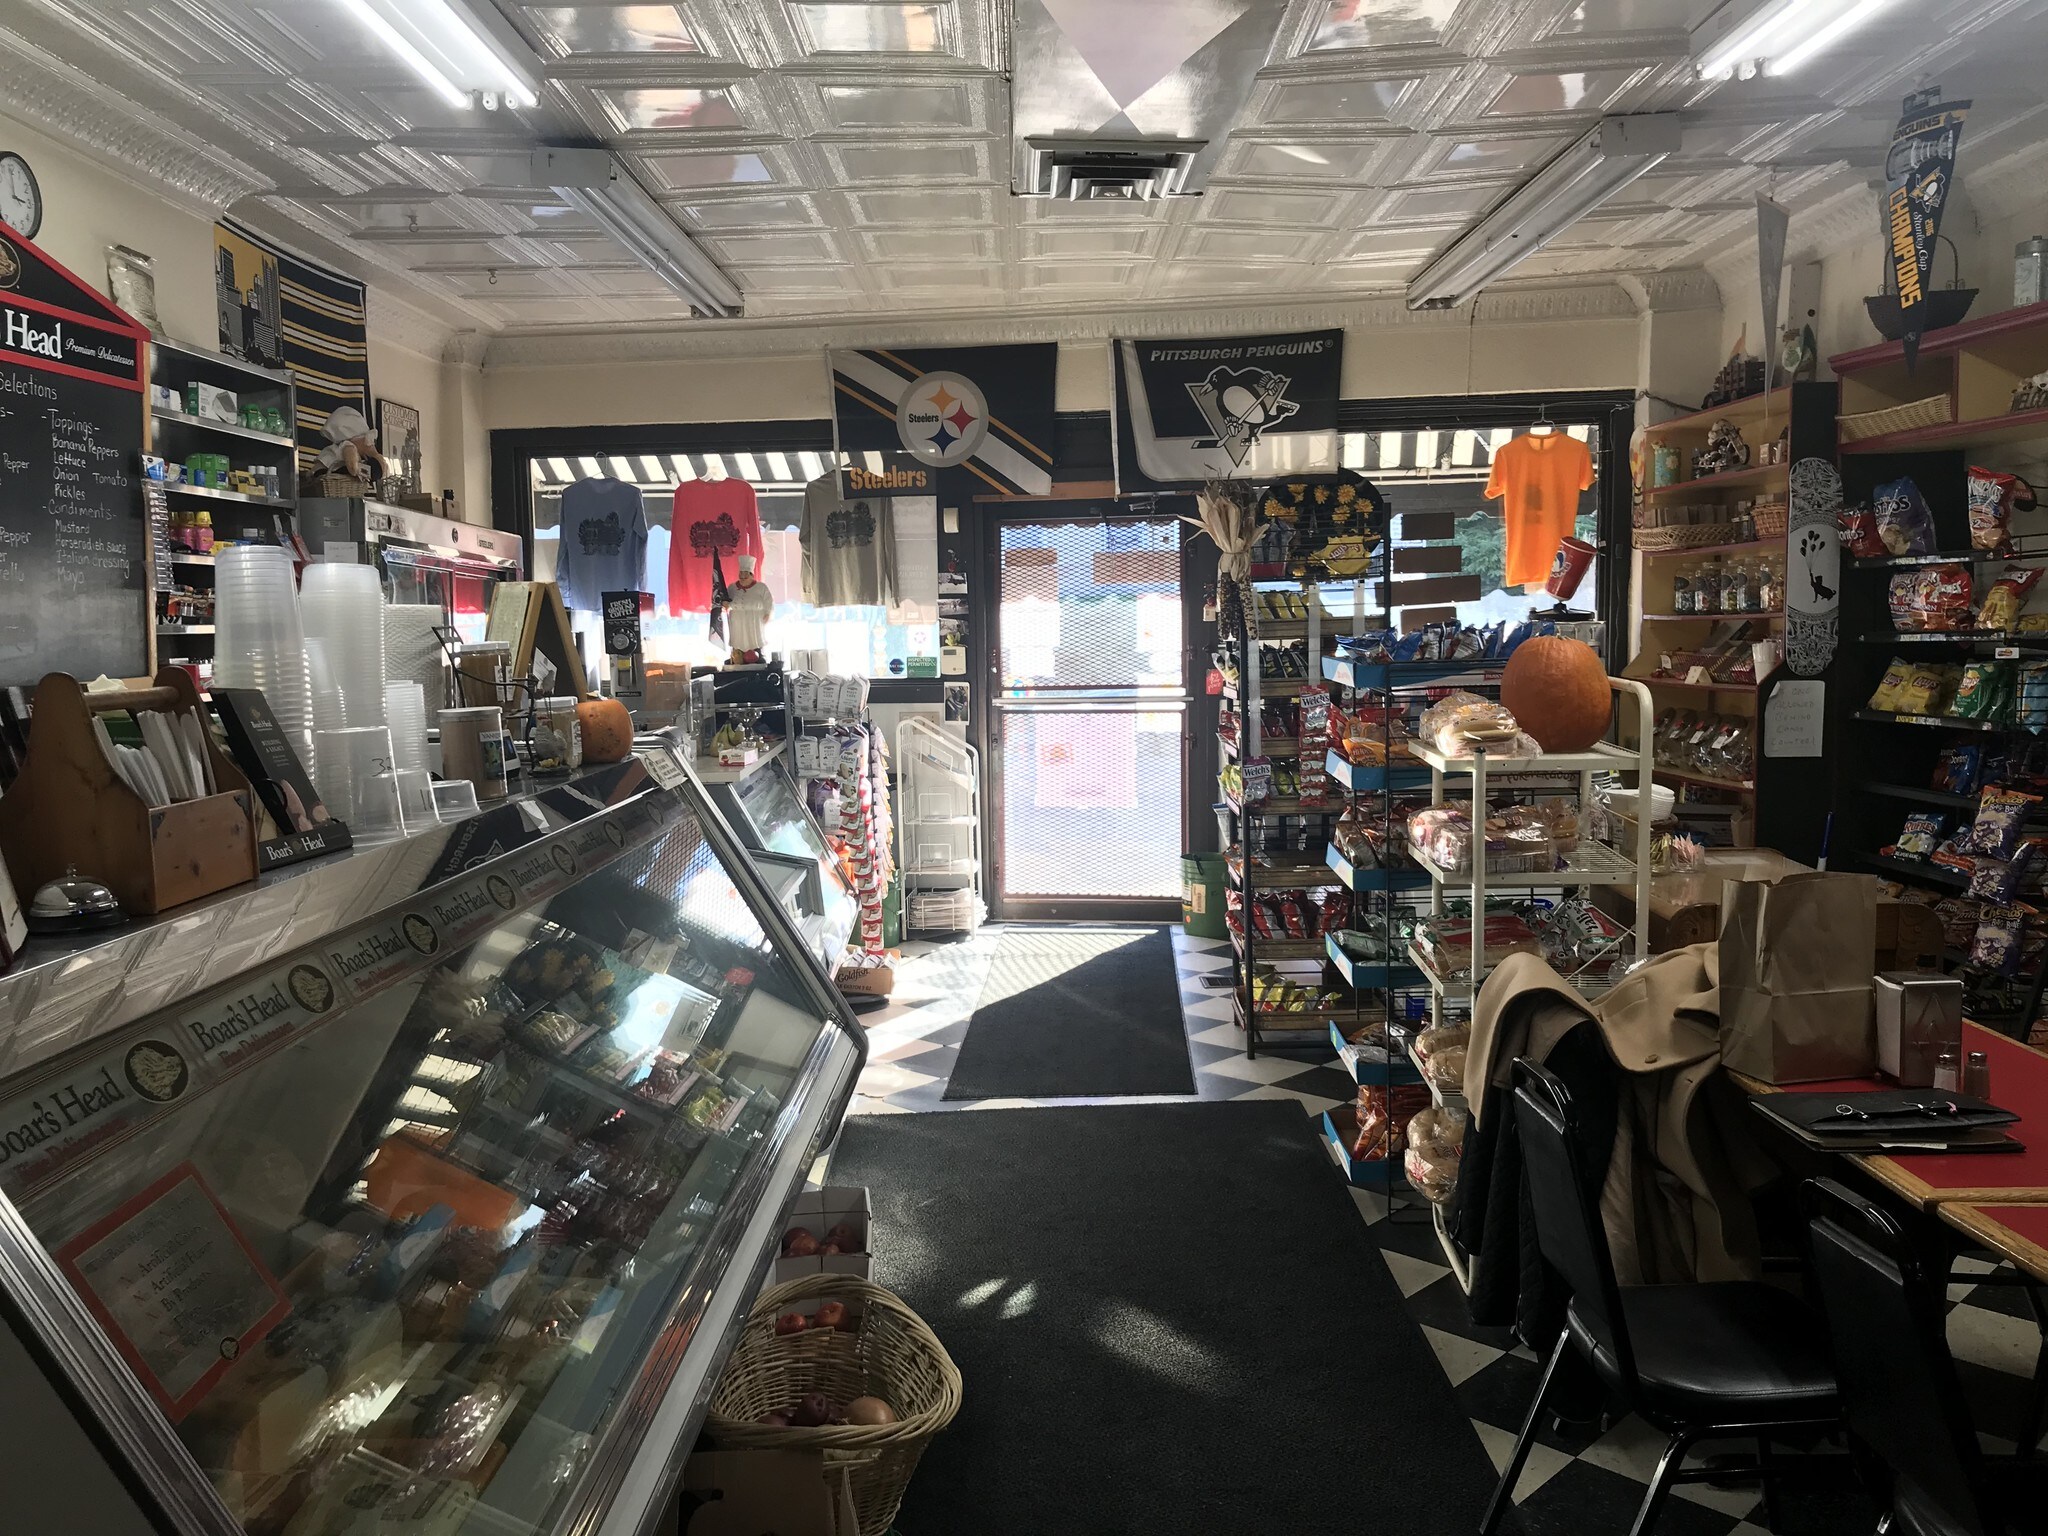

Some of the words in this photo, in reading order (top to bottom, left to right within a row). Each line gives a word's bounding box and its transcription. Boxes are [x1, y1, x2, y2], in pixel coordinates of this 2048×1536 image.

[1914, 211, 1925, 250] Stanley
[1924, 217, 1934, 237] 2016
[1889, 186, 1921, 309] CHAMPIONS
[1918, 249, 1927, 271] Cup
[4, 308, 62, 359] Head
[65, 338, 96, 357] Premium
[97, 346, 135, 366] Delicatessen
[1151, 347, 1241, 361] PITTSBURGH
[1246, 340, 1323, 358] PENGUINS
[908, 413, 940, 423] Steelers
[52, 433, 86, 453] Banana
[88, 438, 119, 460] Peppers
[3, 452, 30, 473] Pepper
[53, 451, 87, 468] Lettuce
[53, 466, 80, 481] Onion
[92, 470, 128, 487] Tomato
[850, 465, 927, 490] Steelers
[54, 483, 86, 500] Pickles
[55, 519, 90, 534] Mustard
[57, 566, 85, 591] Mayo
[609, 598, 632, 609] FRESH
[609, 610, 635, 619] COFFEE
[1302, 695, 1330, 707] Welch's
[1244, 765, 1270, 776] Welch's
[266, 841, 294, 860] Boar's
[300, 833, 326, 851] Head
[511, 861, 538, 887] Boar's
[530, 853, 553, 877] Head
[434, 896, 467, 926] Boar's
[459, 885, 490, 913] Head
[331, 941, 375, 977] Boar's
[367, 926, 405, 961] Head
[189, 1004, 249, 1052] Boar's
[238, 982, 290, 1026] Head
[50, 1066, 125, 1126] Head
